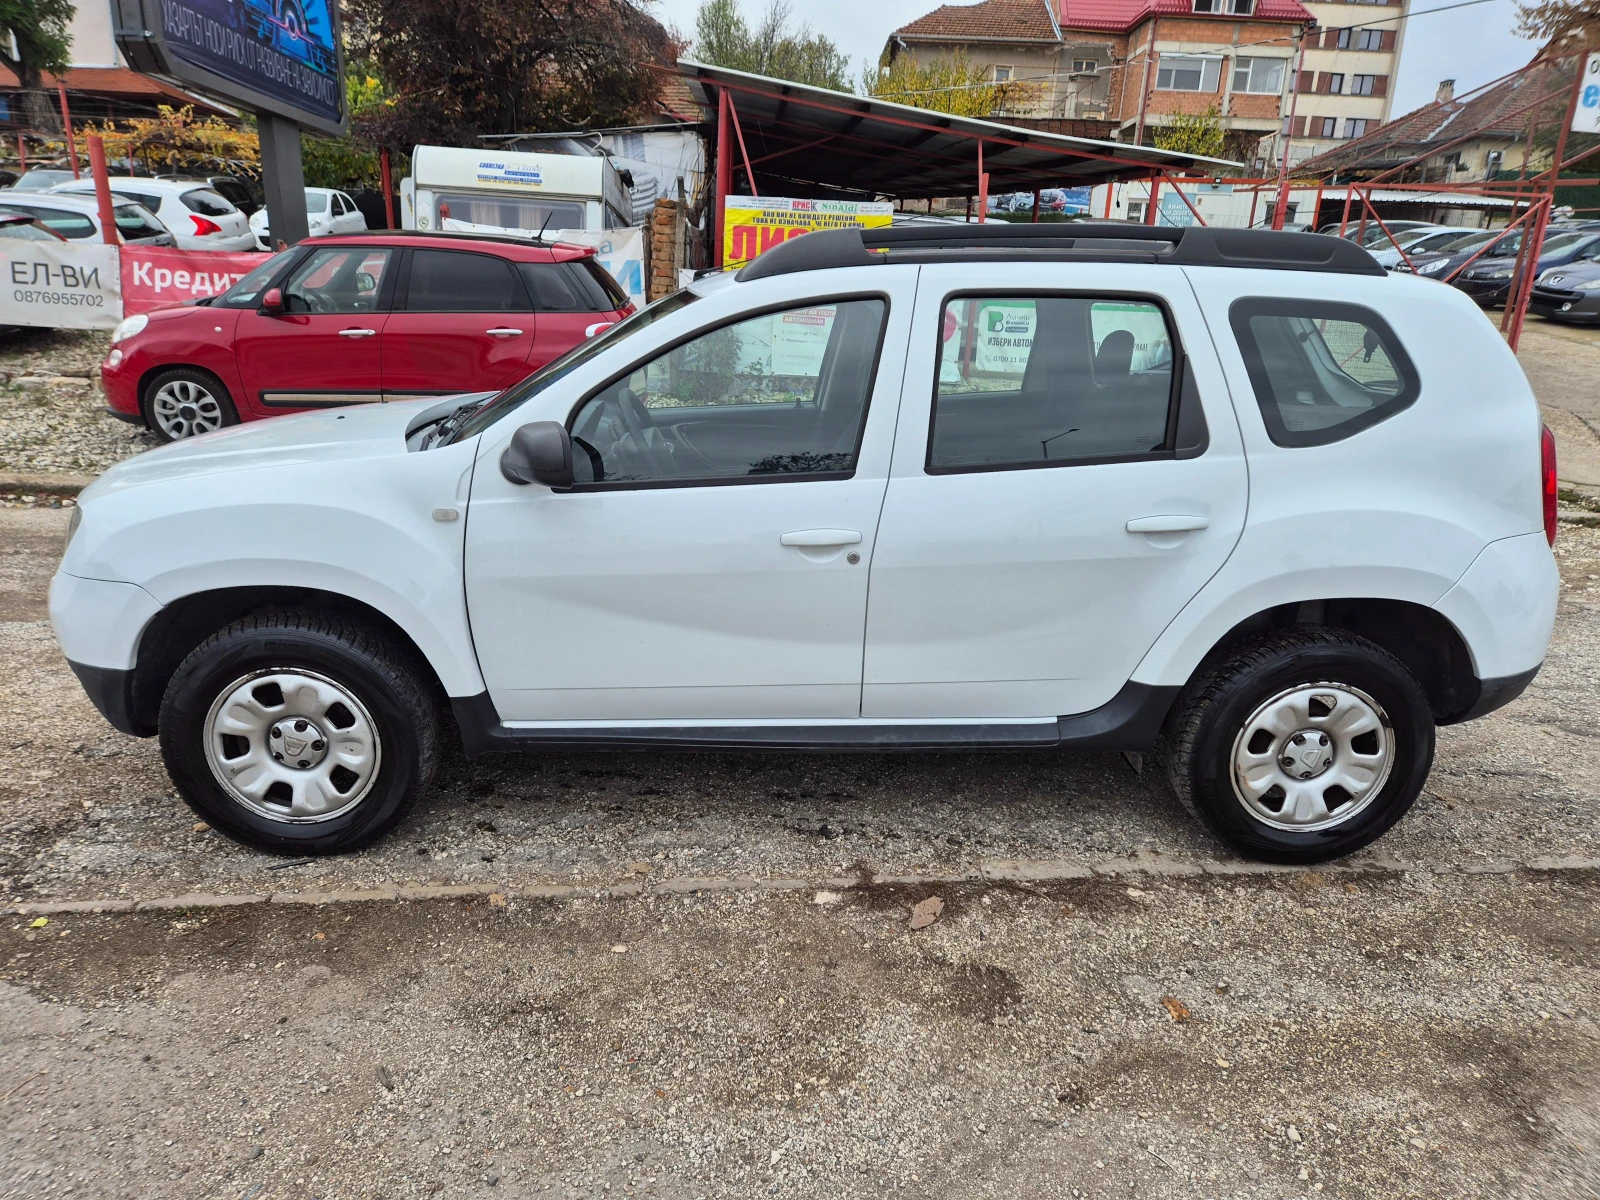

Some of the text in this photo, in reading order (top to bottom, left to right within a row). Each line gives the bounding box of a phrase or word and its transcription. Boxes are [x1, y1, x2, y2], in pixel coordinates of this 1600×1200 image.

[205, 16, 228, 57] НОСИ
[227, 28, 247, 66] РИСК
[248, 38, 257, 70] ОТ
[256, 42, 292, 87] РАЗВИВАНЕ
[292, 61, 301, 90] НА
[300, 67, 334, 106] ЗАВИСИМОСТ
[479, 162, 504, 170] FIAT
[792, 200, 811, 209] КРИС
[821, 202, 858, 214] NinAldi
[776, 211, 788, 219] ВИЕ
[798, 213, 827, 221] ВИЖДАТЕ
[11, 261, 102, 289] ЕЛ-ВИ
[133, 261, 244, 295] Кредит
[14, 290, 104, 307] 0876955702
[784, 316, 824, 325] АВТОМОБИЛИ
[1005, 312, 1031, 321] Лични
[987, 336, 1012, 347] ИЗБЕРИ
[993, 355, 1008, 363] 0700
